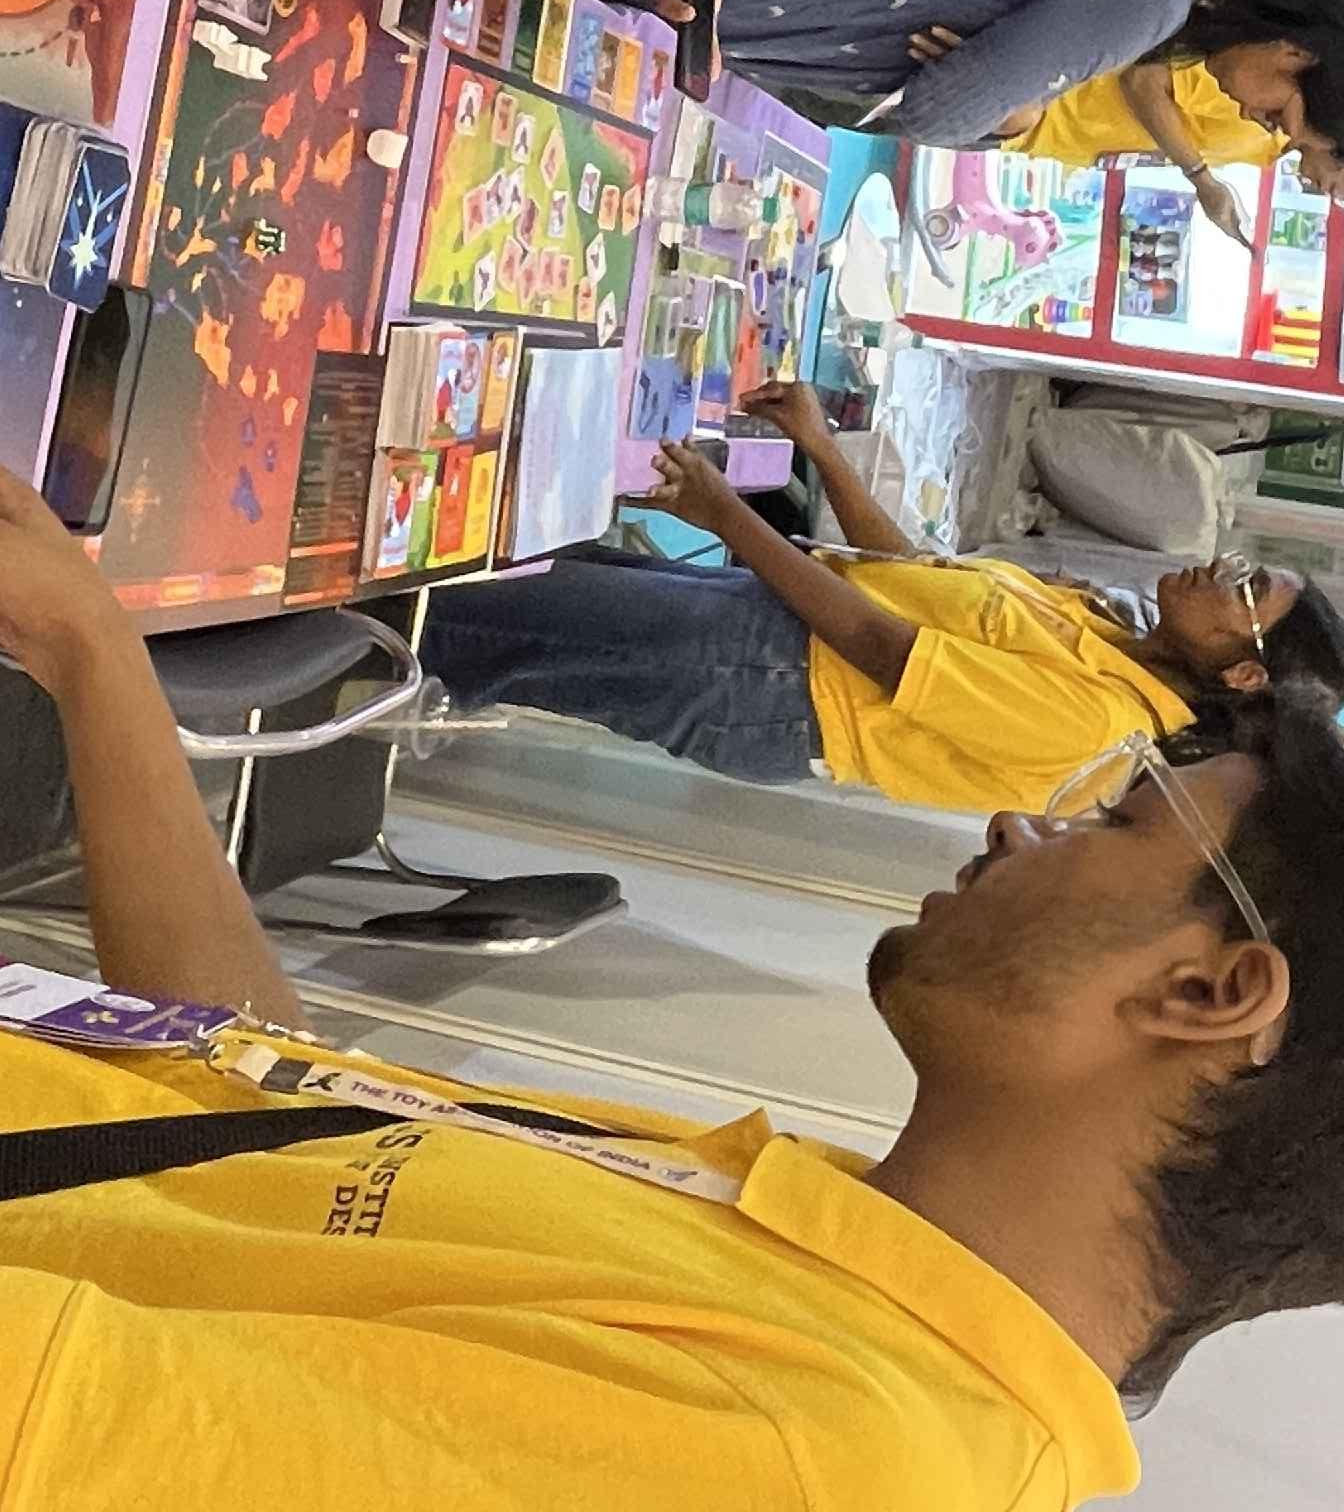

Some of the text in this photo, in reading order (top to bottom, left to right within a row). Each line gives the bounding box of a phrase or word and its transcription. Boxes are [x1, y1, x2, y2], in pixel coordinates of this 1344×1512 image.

[351, 1081, 386, 1099] THE
[392, 1092, 426, 1110] TOY
[597, 1150, 650, 1171] INDIA
[321, 1185, 358, 1236] DES
